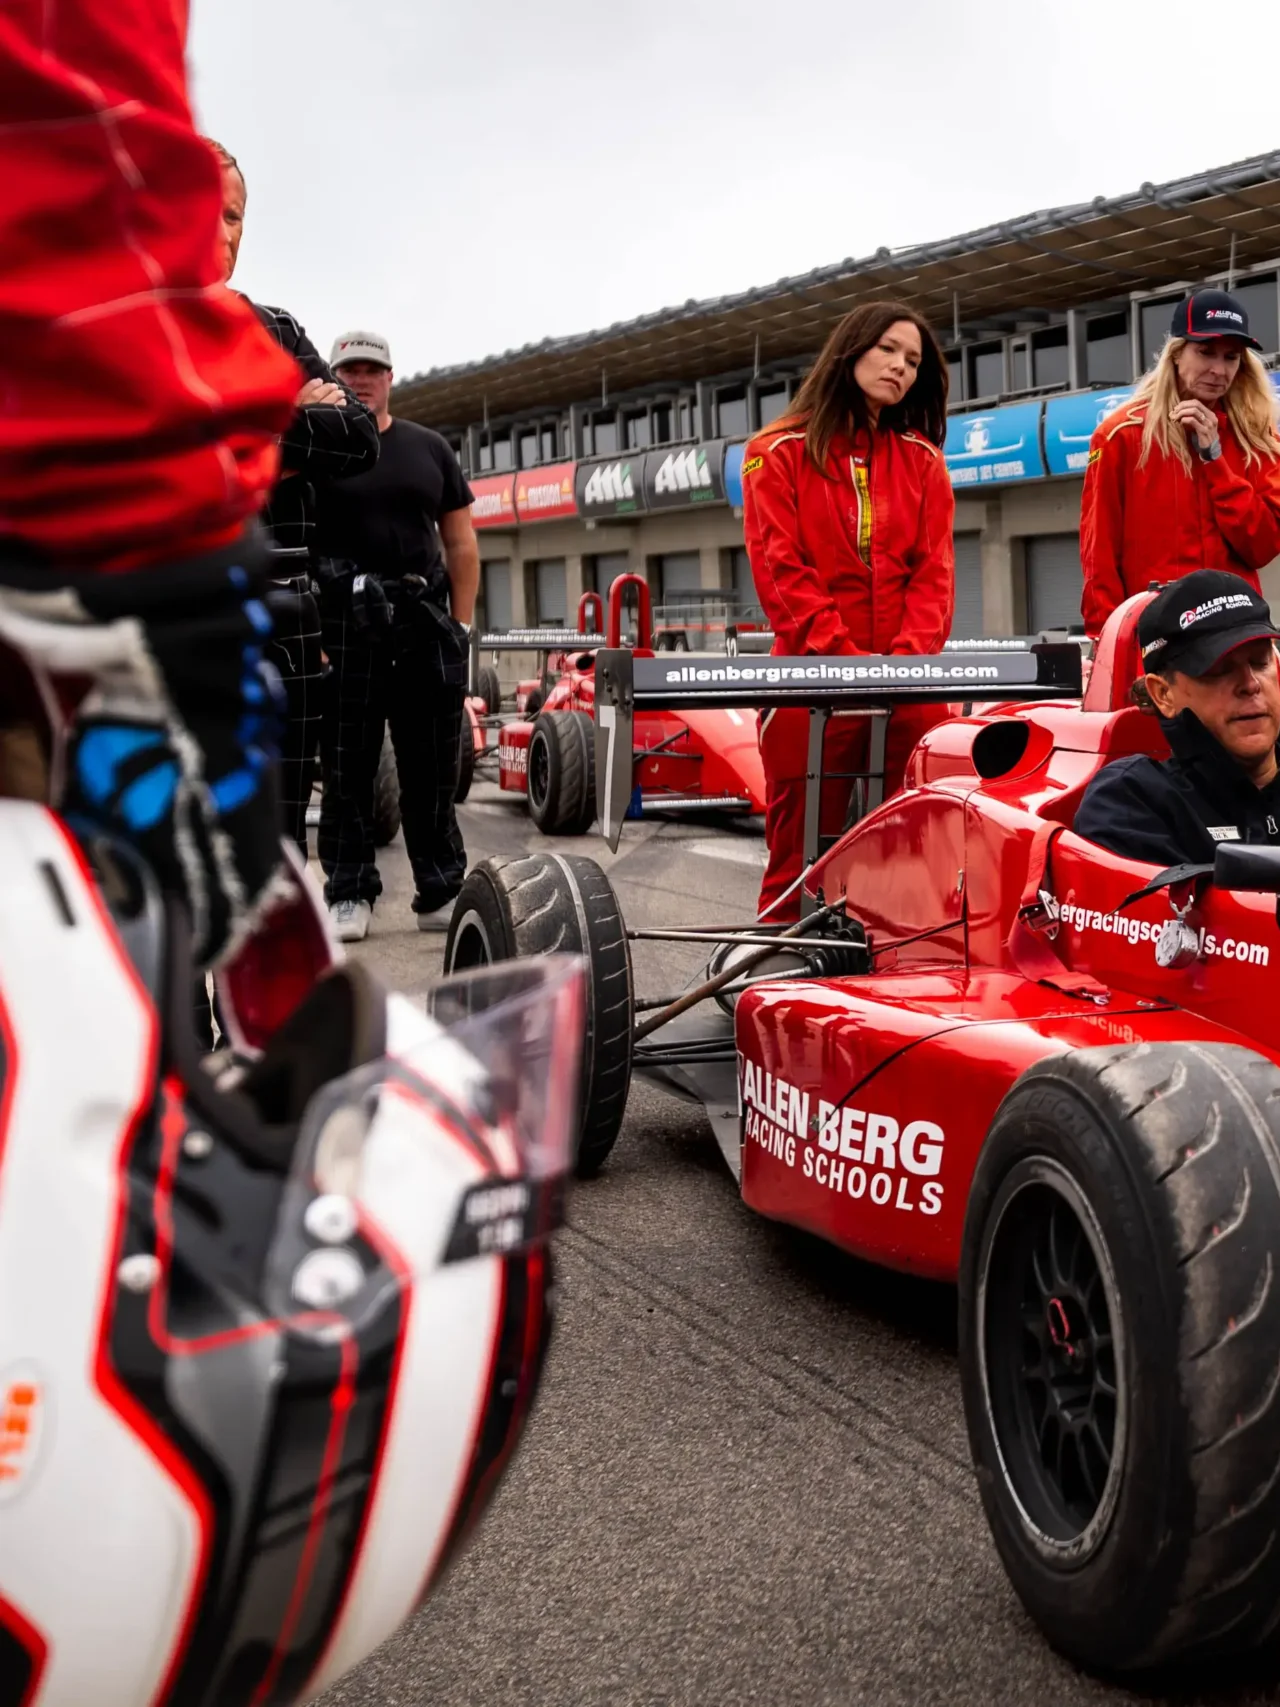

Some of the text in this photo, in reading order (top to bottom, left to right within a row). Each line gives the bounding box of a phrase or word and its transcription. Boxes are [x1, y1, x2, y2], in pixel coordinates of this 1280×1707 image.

[1194, 605, 1223, 621] RACING
[1195, 593, 1252, 615] ALLEN BERG
[666, 663, 998, 683] allenbergracingschools.com
[599, 705, 616, 838] 7
[743, 1059, 945, 1177] ALLEN BERG
[745, 1106, 945, 1216] RACING SCHOOLS
